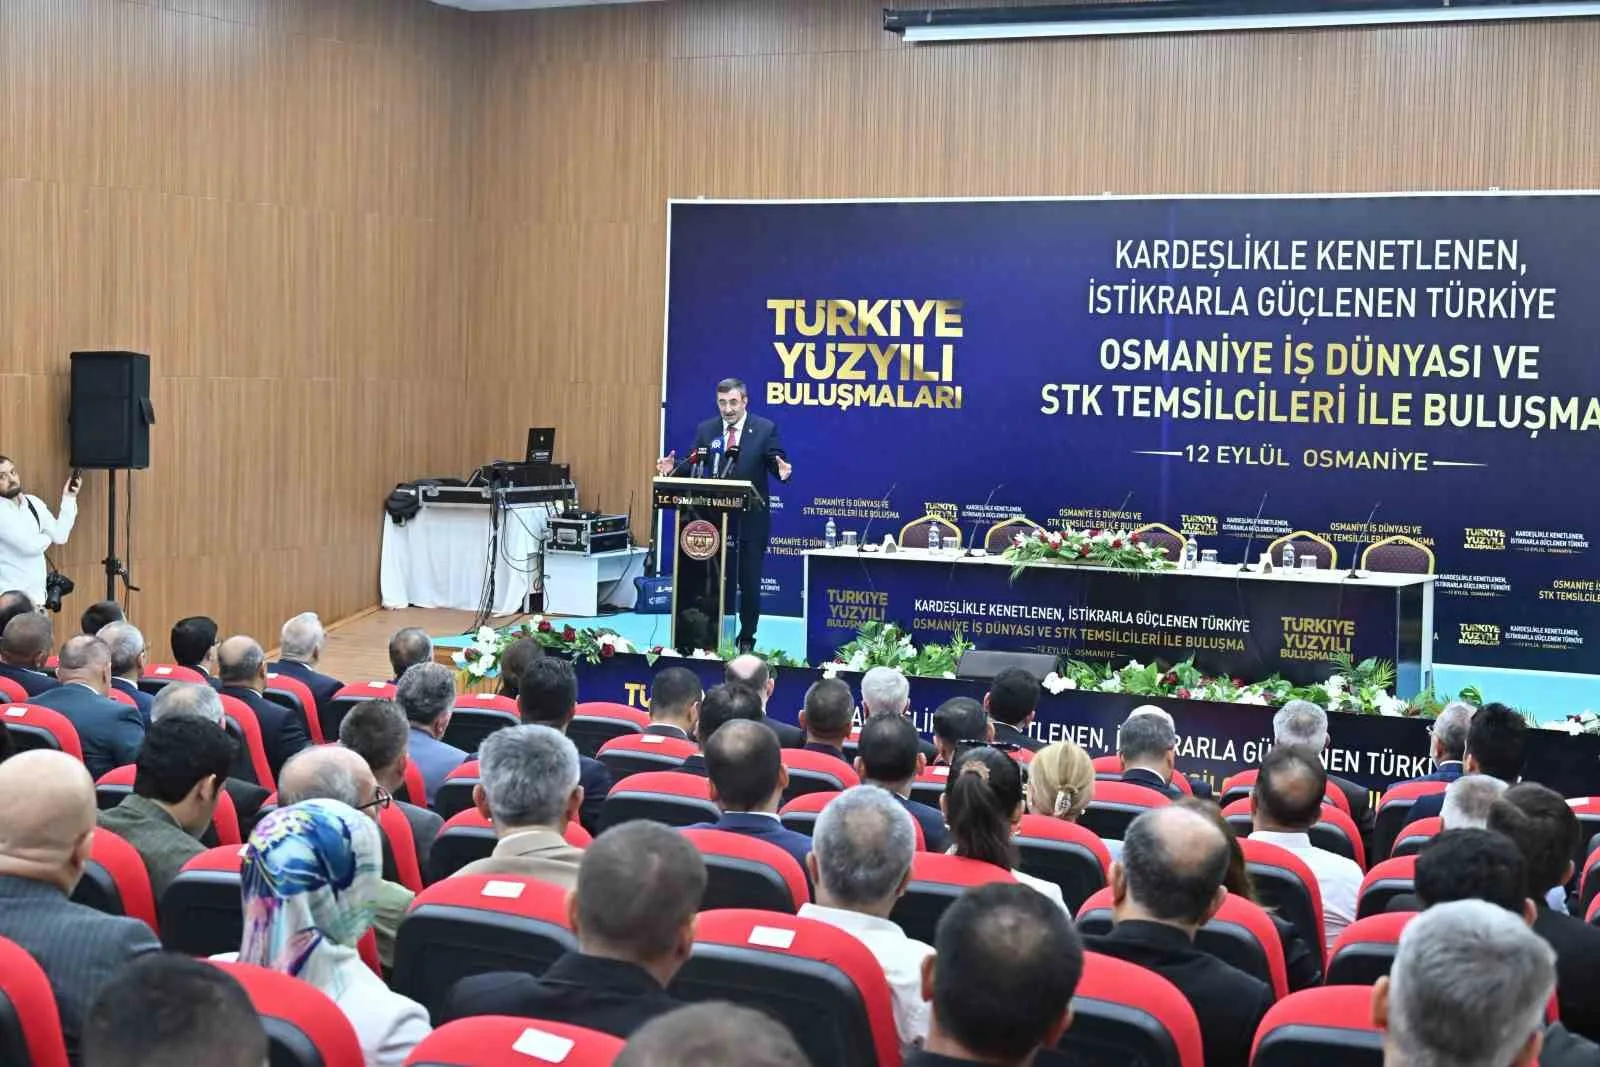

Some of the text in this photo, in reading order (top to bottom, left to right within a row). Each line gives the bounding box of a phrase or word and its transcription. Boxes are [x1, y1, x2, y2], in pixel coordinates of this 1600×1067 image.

[1115, 233, 1527, 278] KARDEŞLİKLE KENETLENEN,
[1088, 278, 1556, 325] İSTİKRARLA GÜÇLENEN TÜRKİYE
[766, 299, 964, 337] TÜRKİYE
[773, 342, 953, 382] YÜZYILI
[1100, 333, 1540, 383] OSMANİYE İŞ DÜNYASI VE
[766, 382, 962, 411] BULUŞMALARI
[1040, 380, 1600, 438] STK TEMSİLCİLERİ İLE BULUŞMA
[1185, 443, 1429, 471] 12 EYLÜL OSMANİYE
[657, 495, 671, 504] T.C.
[802, 507, 815, 515] STK
[814, 497, 845, 507] OSMANİYE
[1047, 518, 1060, 527] STK
[1059, 508, 1093, 518] OSMANİYE
[1133, 512, 1142, 521] VE
[1330, 522, 1368, 532] OSMANİYE
[1378, 524, 1410, 535] DÜNYASI
[1412, 526, 1422, 535] VE
[1539, 590, 1600, 602] STK TEMSİLCİLE
[1553, 579, 1593, 591] OSMANİYE
[915, 598, 1251, 633] KARDEŞLİKLE KENETLENEN, İSTİKRARLA GÜÇLENEN TÜRKİYE
[913, 619, 1245, 652] OSMANİYE İŞ DÜNYASI VE STK TEMSİLCİLERİ İLE BULUŞMA
[1074, 648, 1117, 658] OSMANİYE
[1280, 648, 1353, 663] BULUŞMAI
[1027, 722, 1433, 778] TLENEN, İRARLA GÜNEN TÜRKİ
